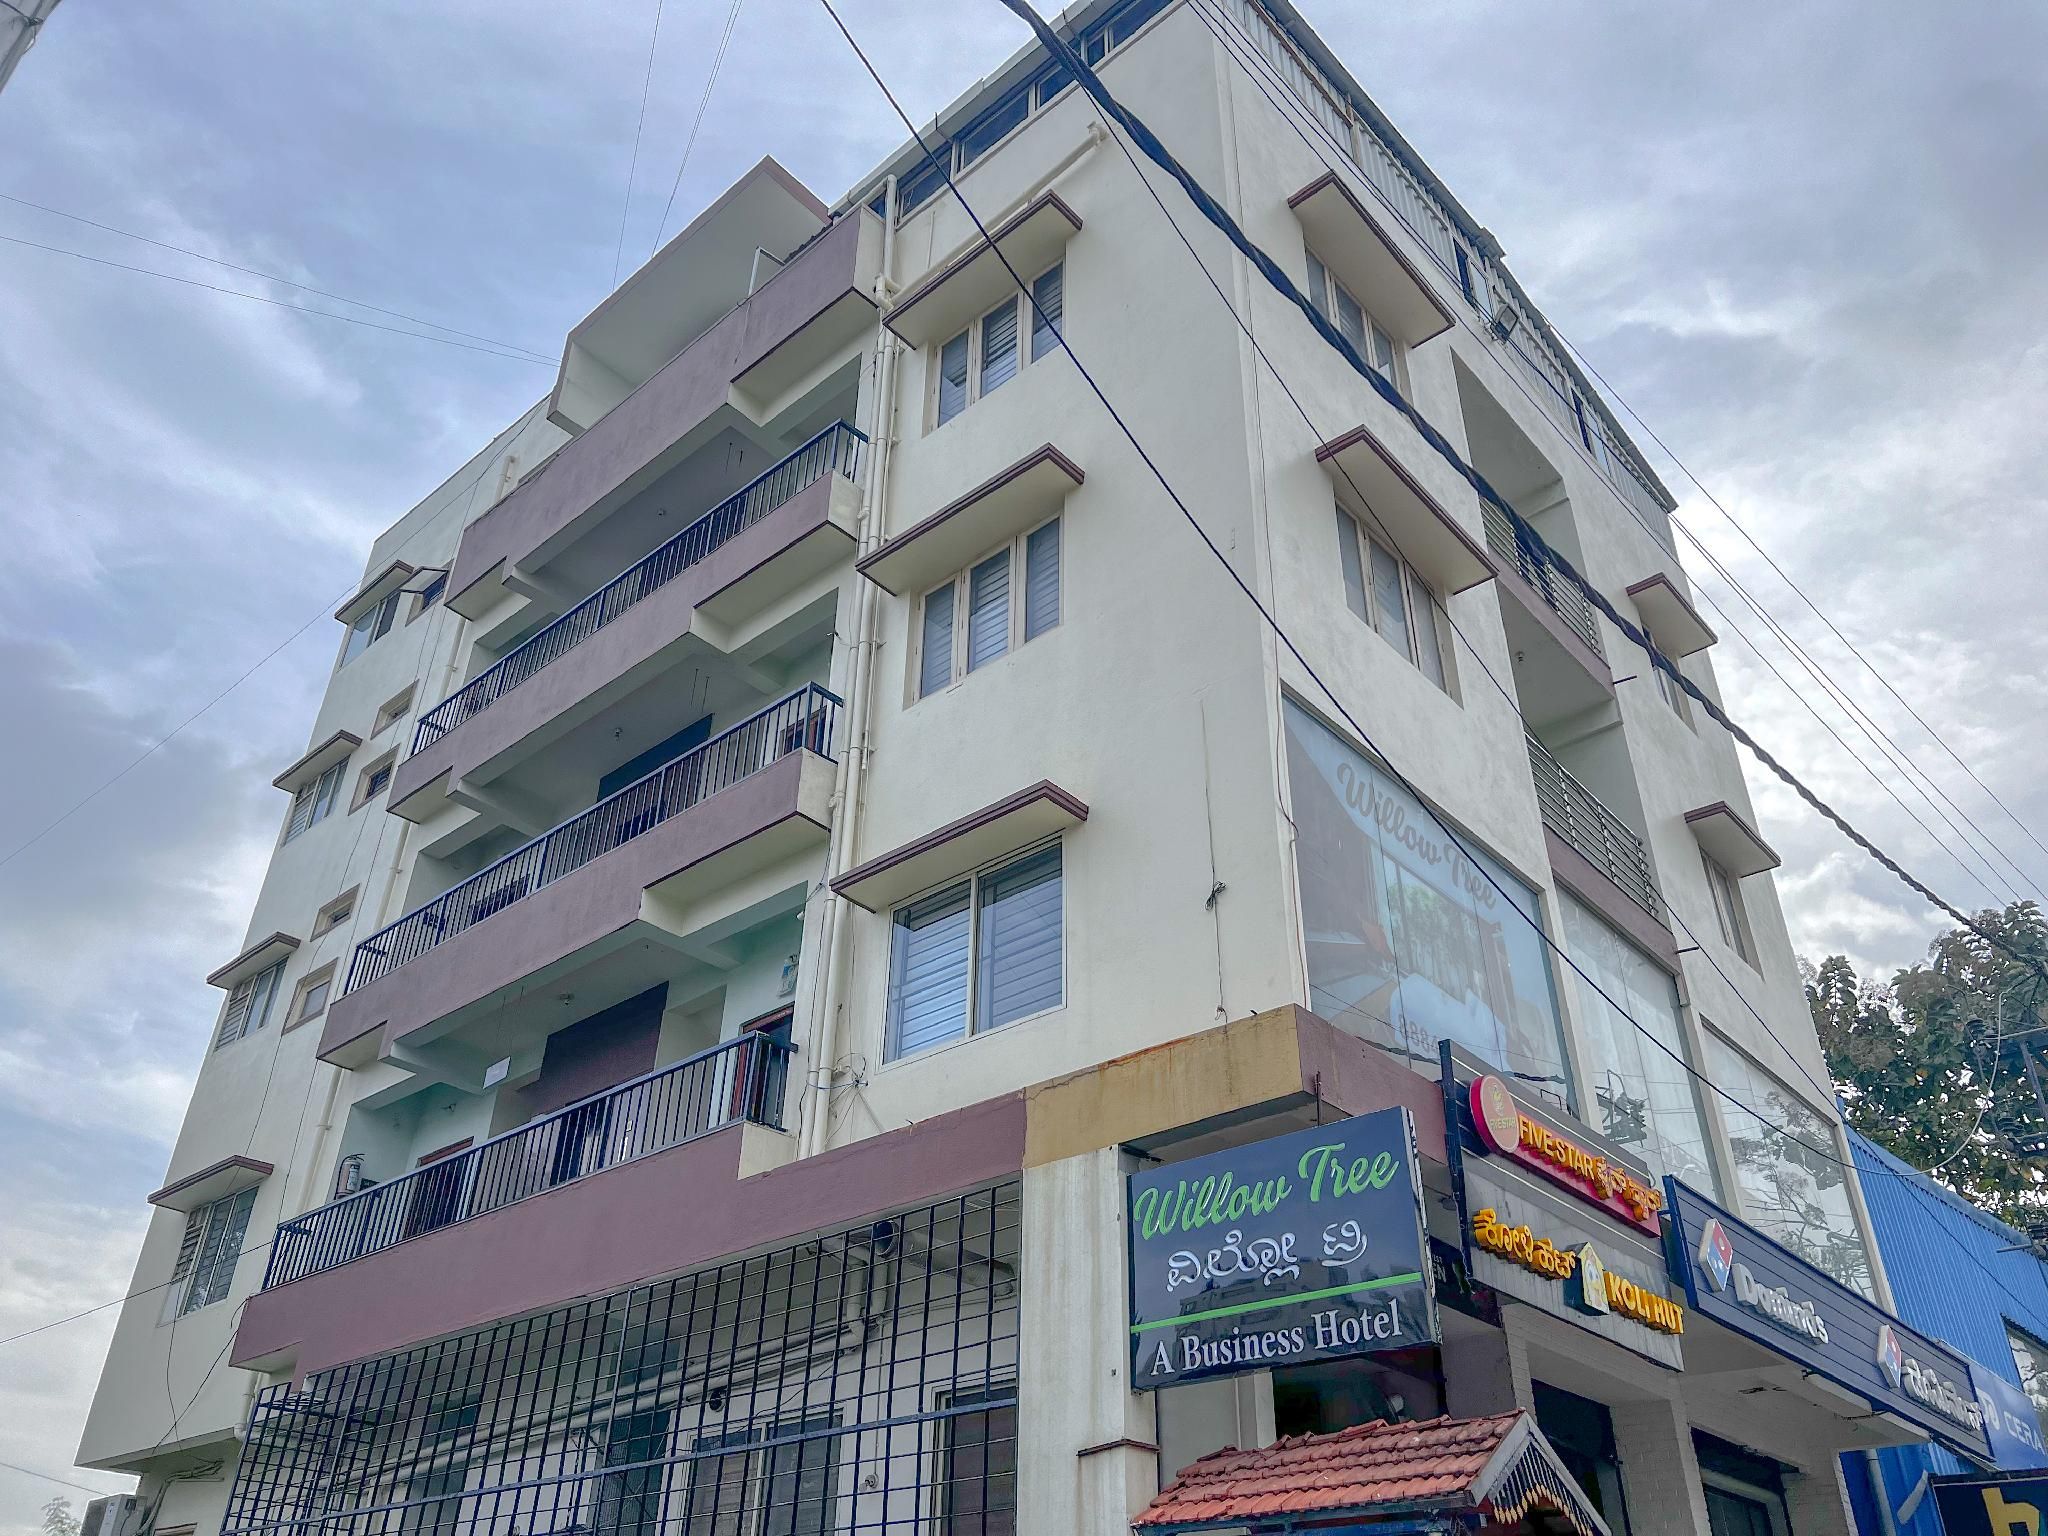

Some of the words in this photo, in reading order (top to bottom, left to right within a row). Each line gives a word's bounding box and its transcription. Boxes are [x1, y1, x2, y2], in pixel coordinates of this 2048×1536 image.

[1337, 763, 1441, 865] Willow
[1443, 843, 1497, 910] Tree
[1134, 1171, 1292, 1240] Willow
[1299, 1142, 1400, 1202] Tree
[1151, 1341, 1175, 1375] A
[1180, 1325, 1305, 1371] Business
[1311, 1299, 1403, 1350] Hotel
[1652, 1293, 1684, 1334] HUT
